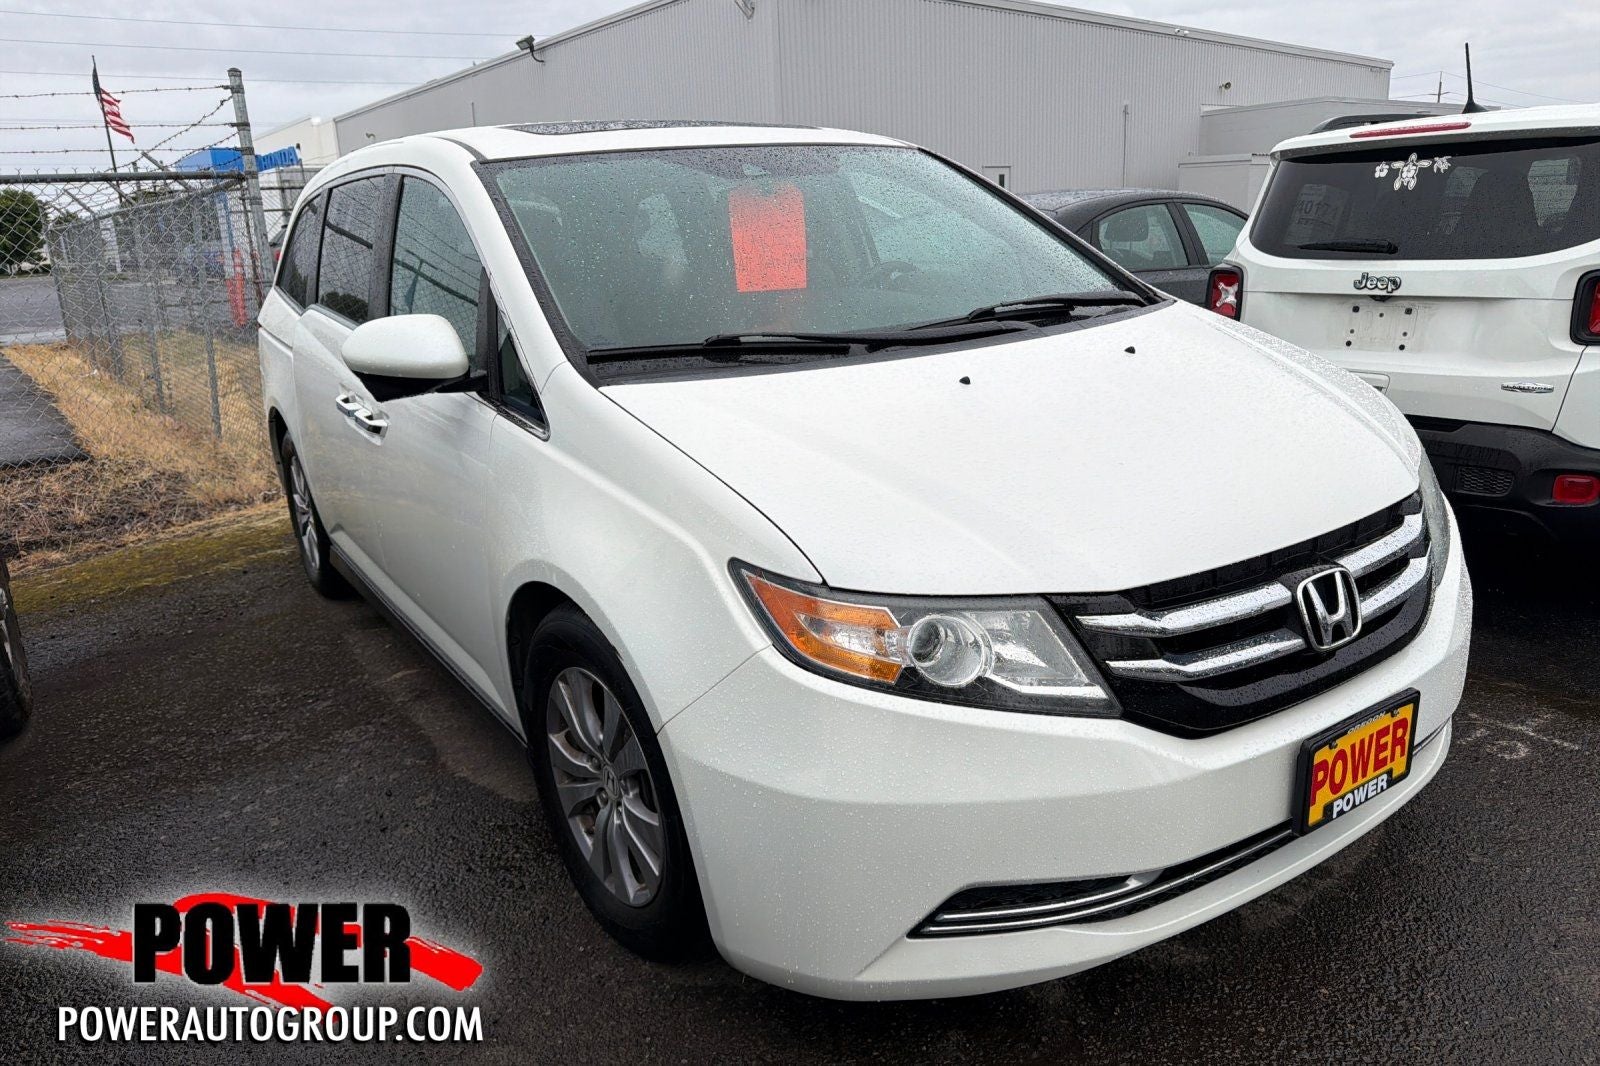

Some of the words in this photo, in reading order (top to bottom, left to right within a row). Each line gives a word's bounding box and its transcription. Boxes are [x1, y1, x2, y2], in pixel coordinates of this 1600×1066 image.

[1354, 272, 1401, 293] Jeep
[1310, 717, 1408, 807] POWER
[1333, 773, 1388, 819] POWER
